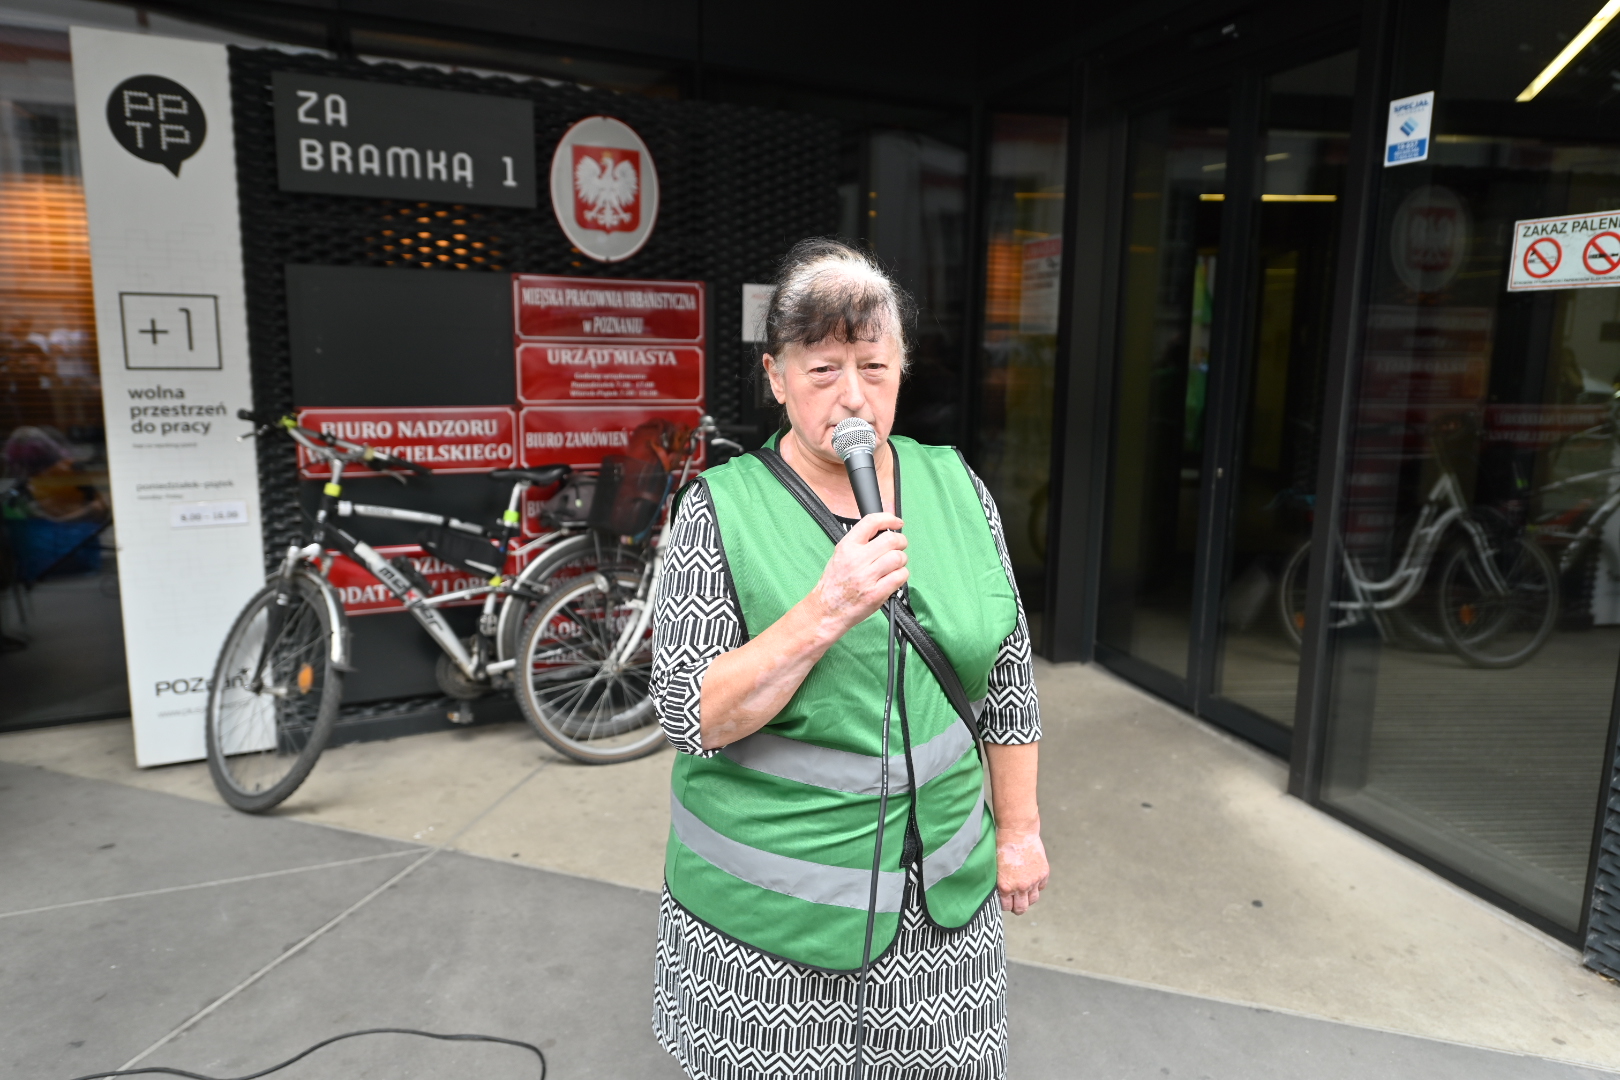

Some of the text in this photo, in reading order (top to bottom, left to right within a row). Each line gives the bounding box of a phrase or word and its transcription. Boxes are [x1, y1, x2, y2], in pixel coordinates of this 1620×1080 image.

[296, 90, 348, 127] ZA
[299, 137, 518, 188] BRAMKĄ 1
[1522, 217, 1620, 238] ZAKAZ PALEN
[522, 287, 697, 310] MIEJSKA PRACOWNIA URBANISTYCZNA
[593, 316, 644, 334] POZNANIU
[546, 348, 677, 368] URZĄD MIASTA
[128, 385, 185, 399] wolna
[130, 402, 227, 420] przestrzeń
[131, 420, 211, 436] do pracy
[320, 418, 499, 440] BIURO NADZORU
[526, 427, 629, 448] BIURO ZAMÓWIEŃ
